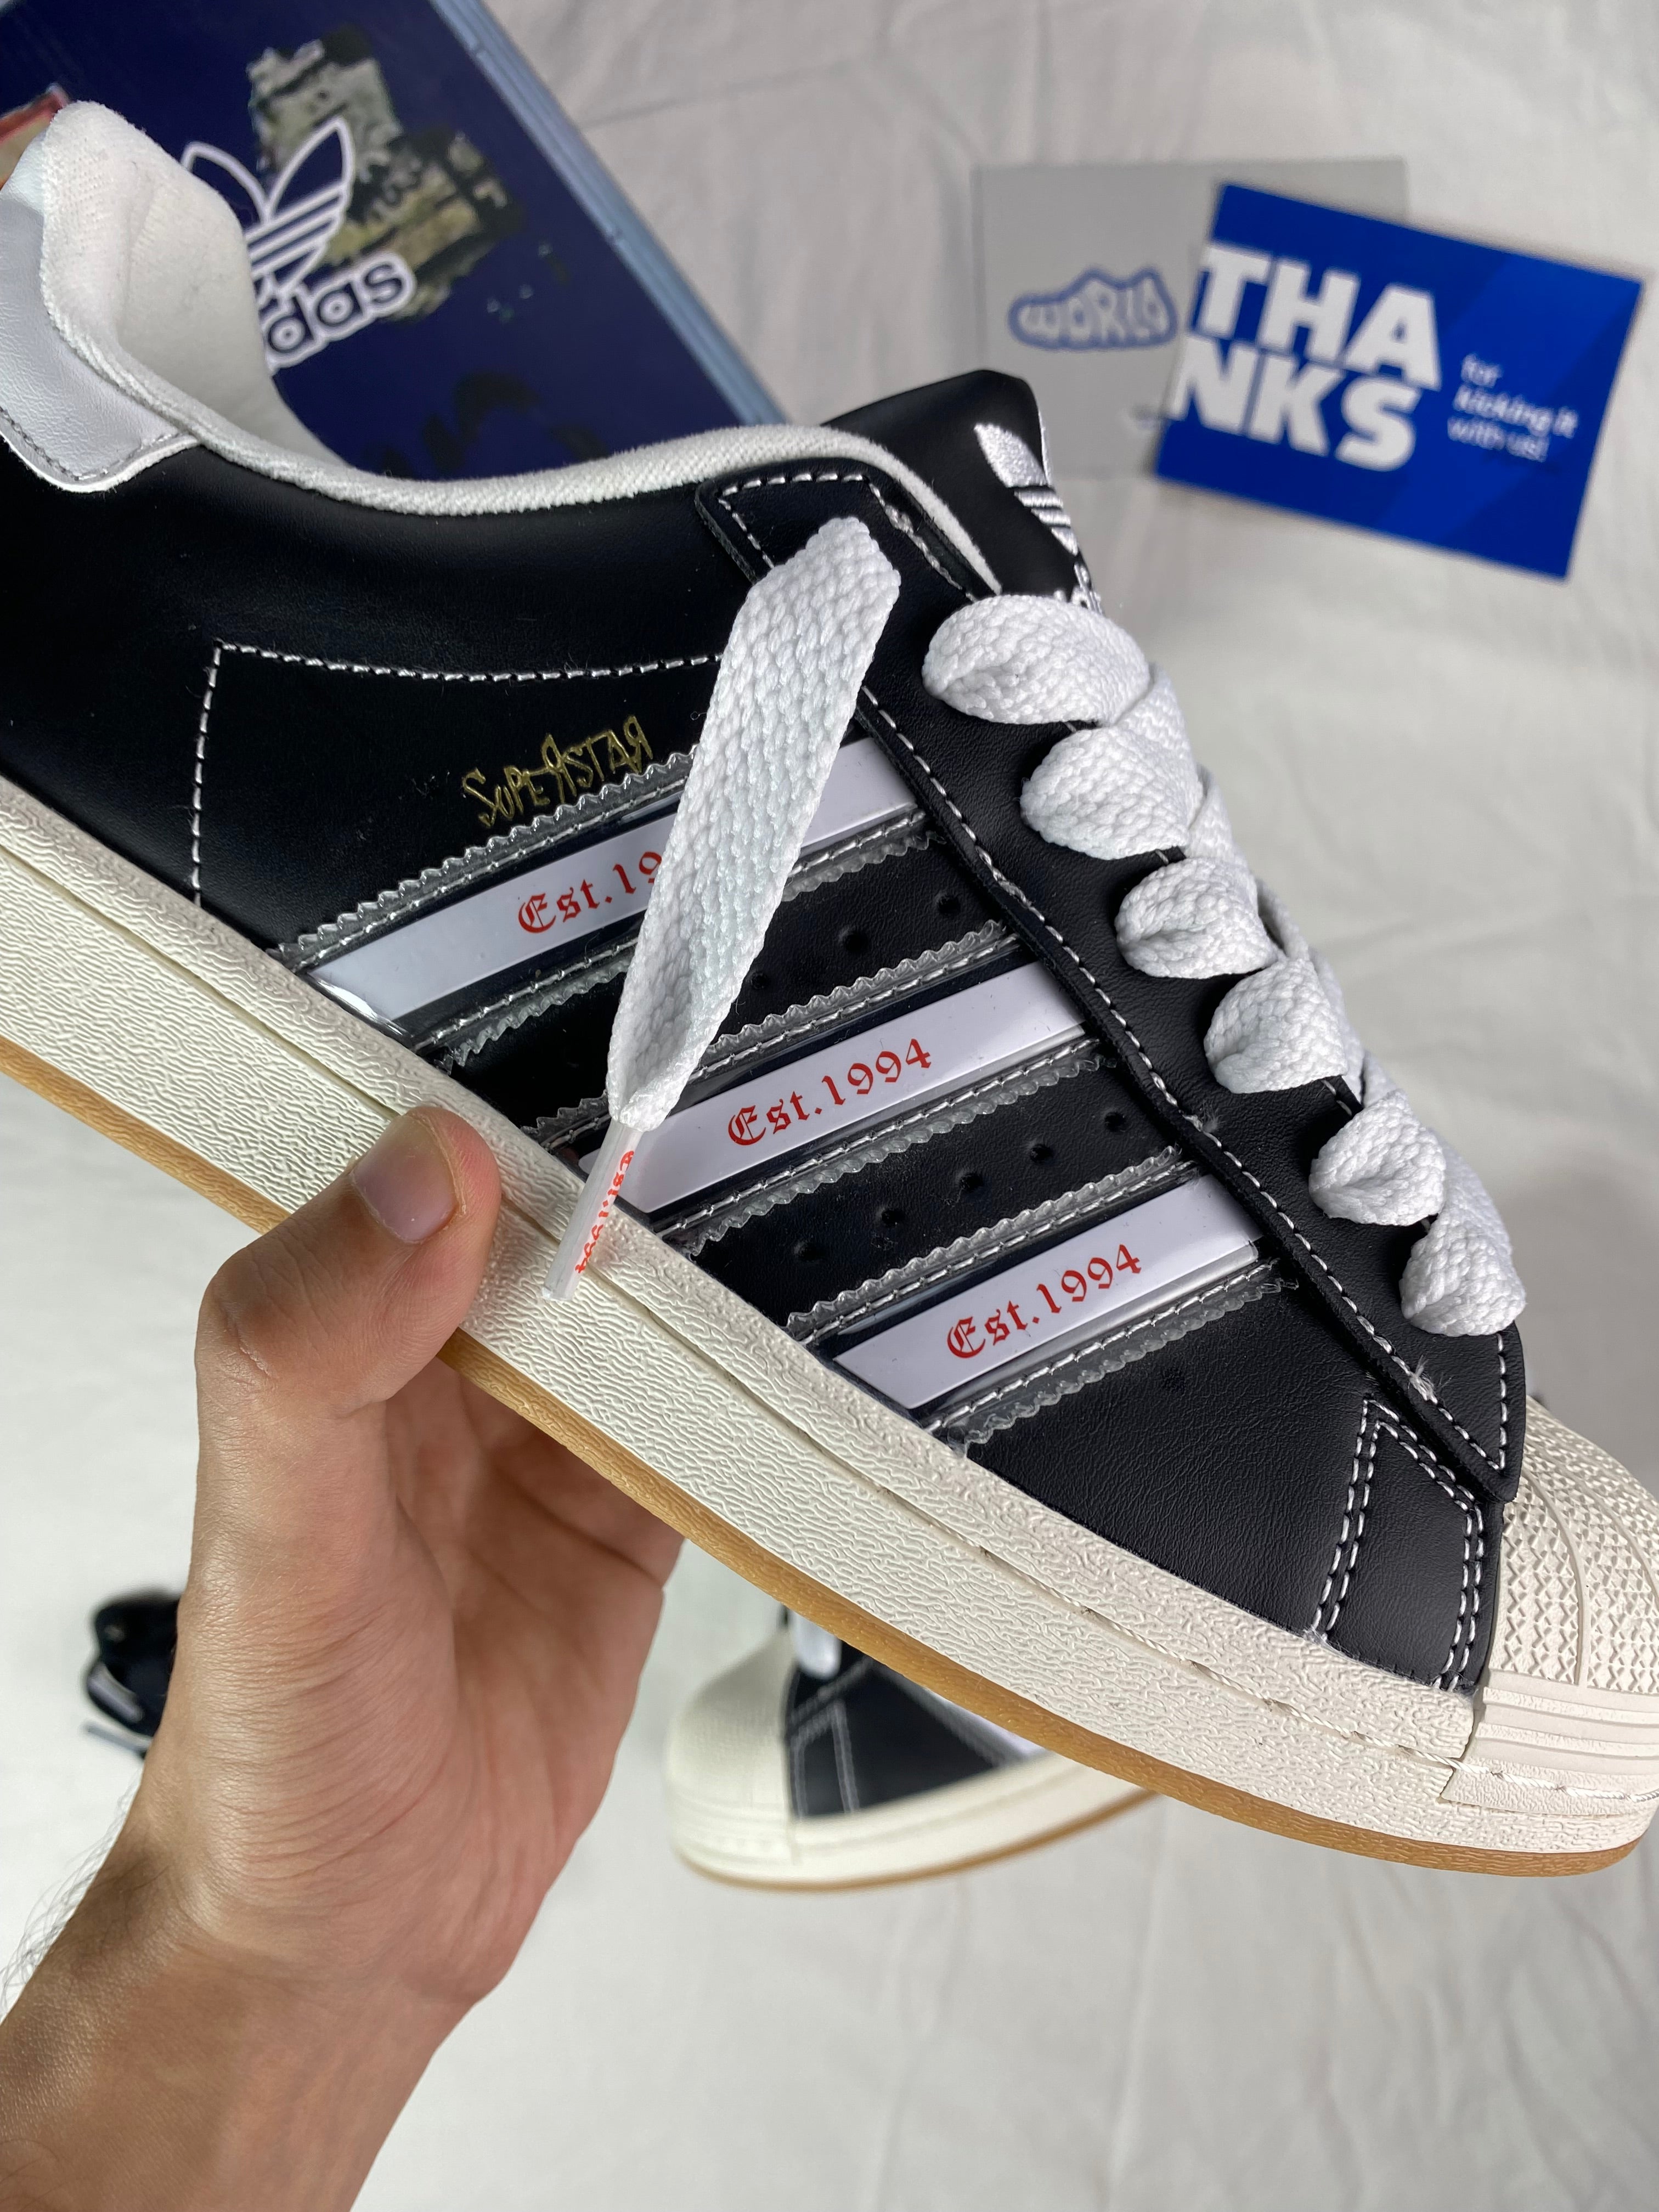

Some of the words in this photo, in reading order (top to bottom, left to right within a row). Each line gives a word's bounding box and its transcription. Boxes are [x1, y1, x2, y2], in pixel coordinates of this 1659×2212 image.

[266, 259, 408, 357] das
[1014, 274, 1174, 345] WORLD
[1200, 244, 1442, 391] THA
[1163, 332, 1424, 472] NKS
[518, 851, 662, 933] Est.19
[728, 1039, 931, 1146] Est.1994
[947, 1244, 1141, 1358] Est.1994
